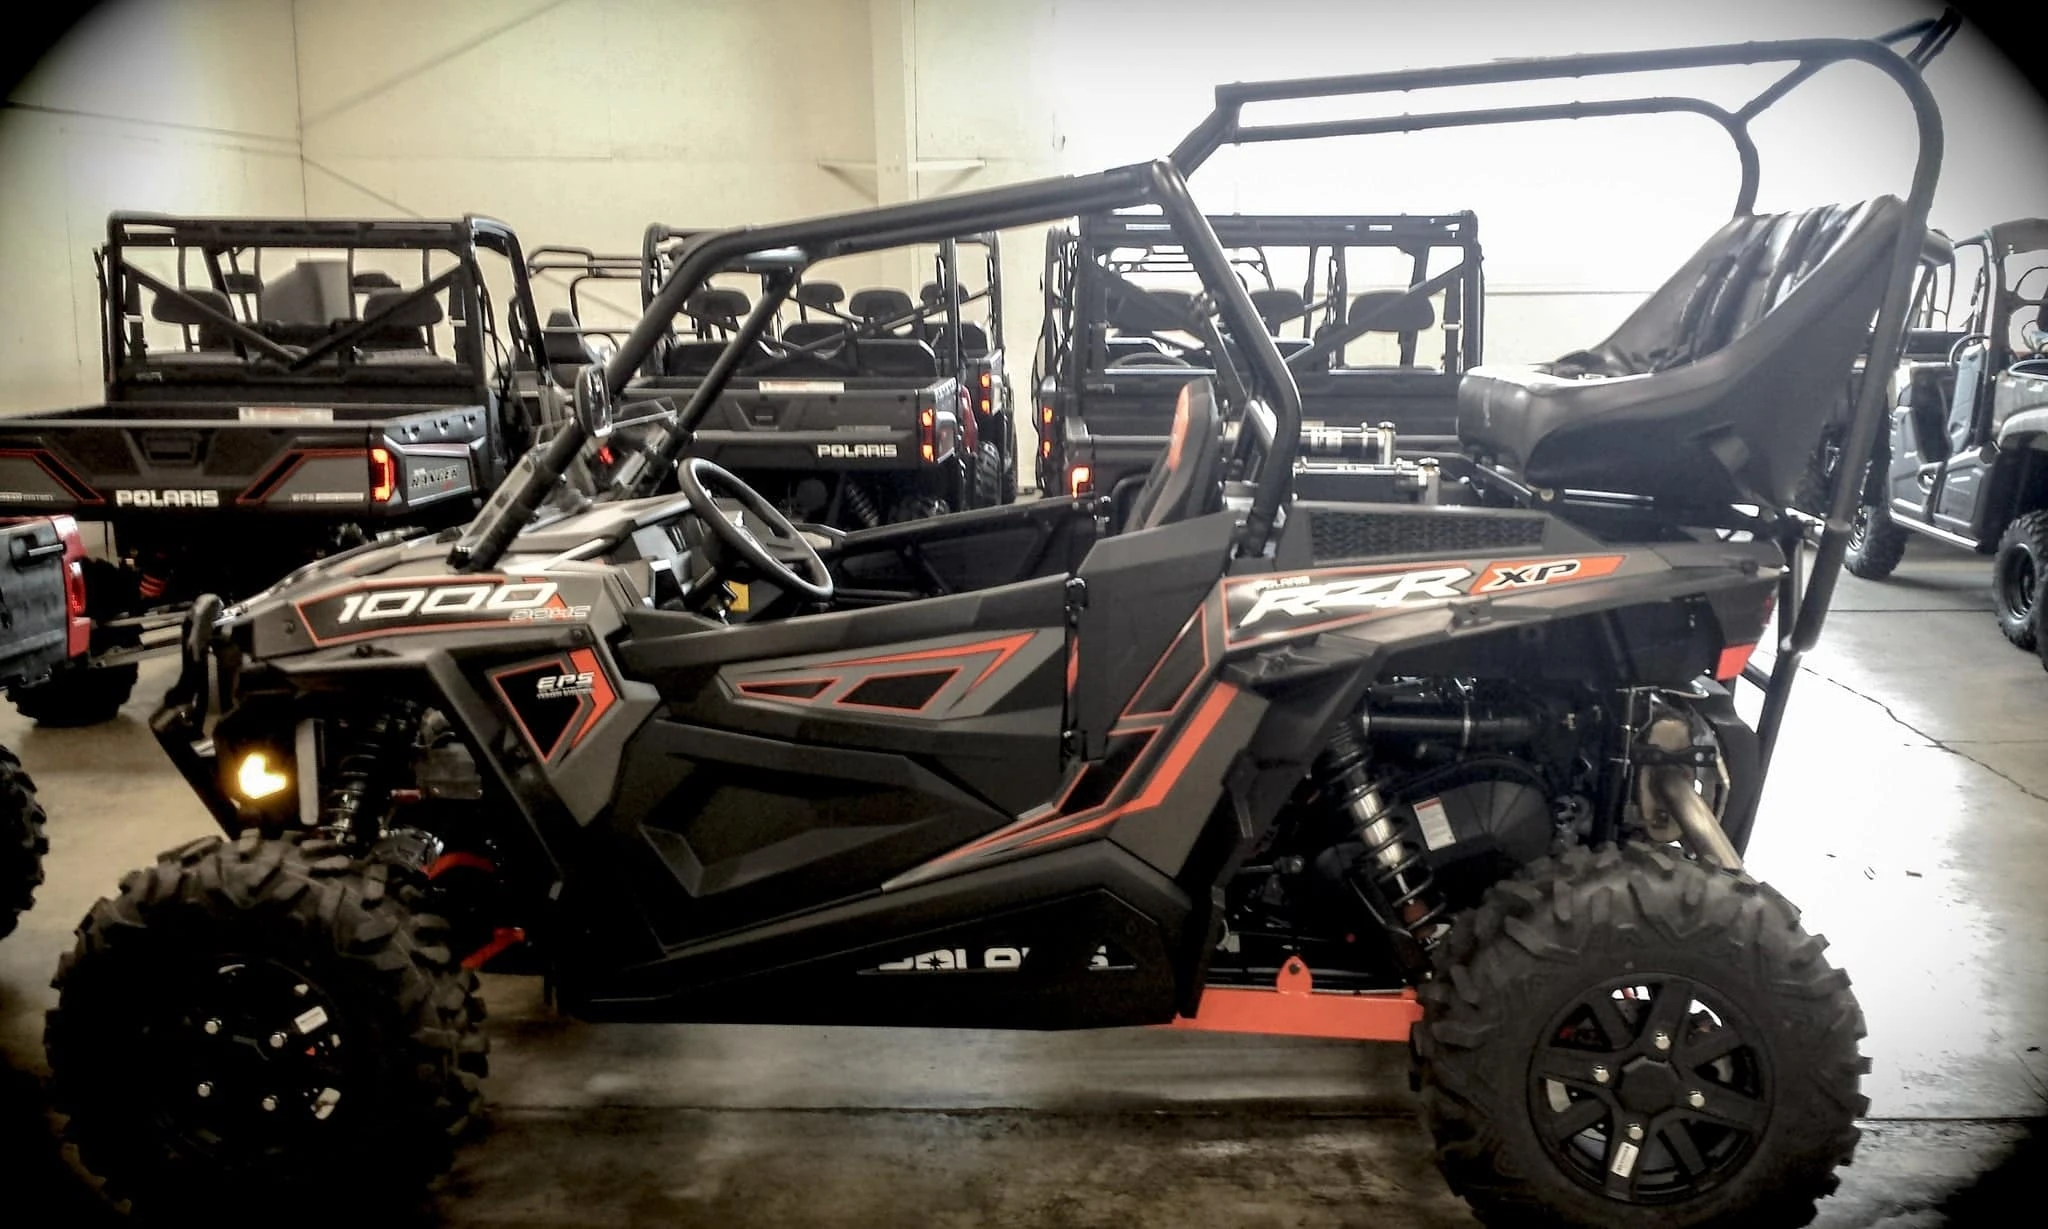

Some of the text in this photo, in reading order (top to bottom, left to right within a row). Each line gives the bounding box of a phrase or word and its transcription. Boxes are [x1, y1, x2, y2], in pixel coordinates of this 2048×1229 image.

[816, 443, 898, 459] POLARIS
[115, 489, 219, 507] POLARIS
[338, 582, 558, 624] 1000
[1238, 560, 1580, 628] RZR XP
[536, 672, 594, 690] EPS
